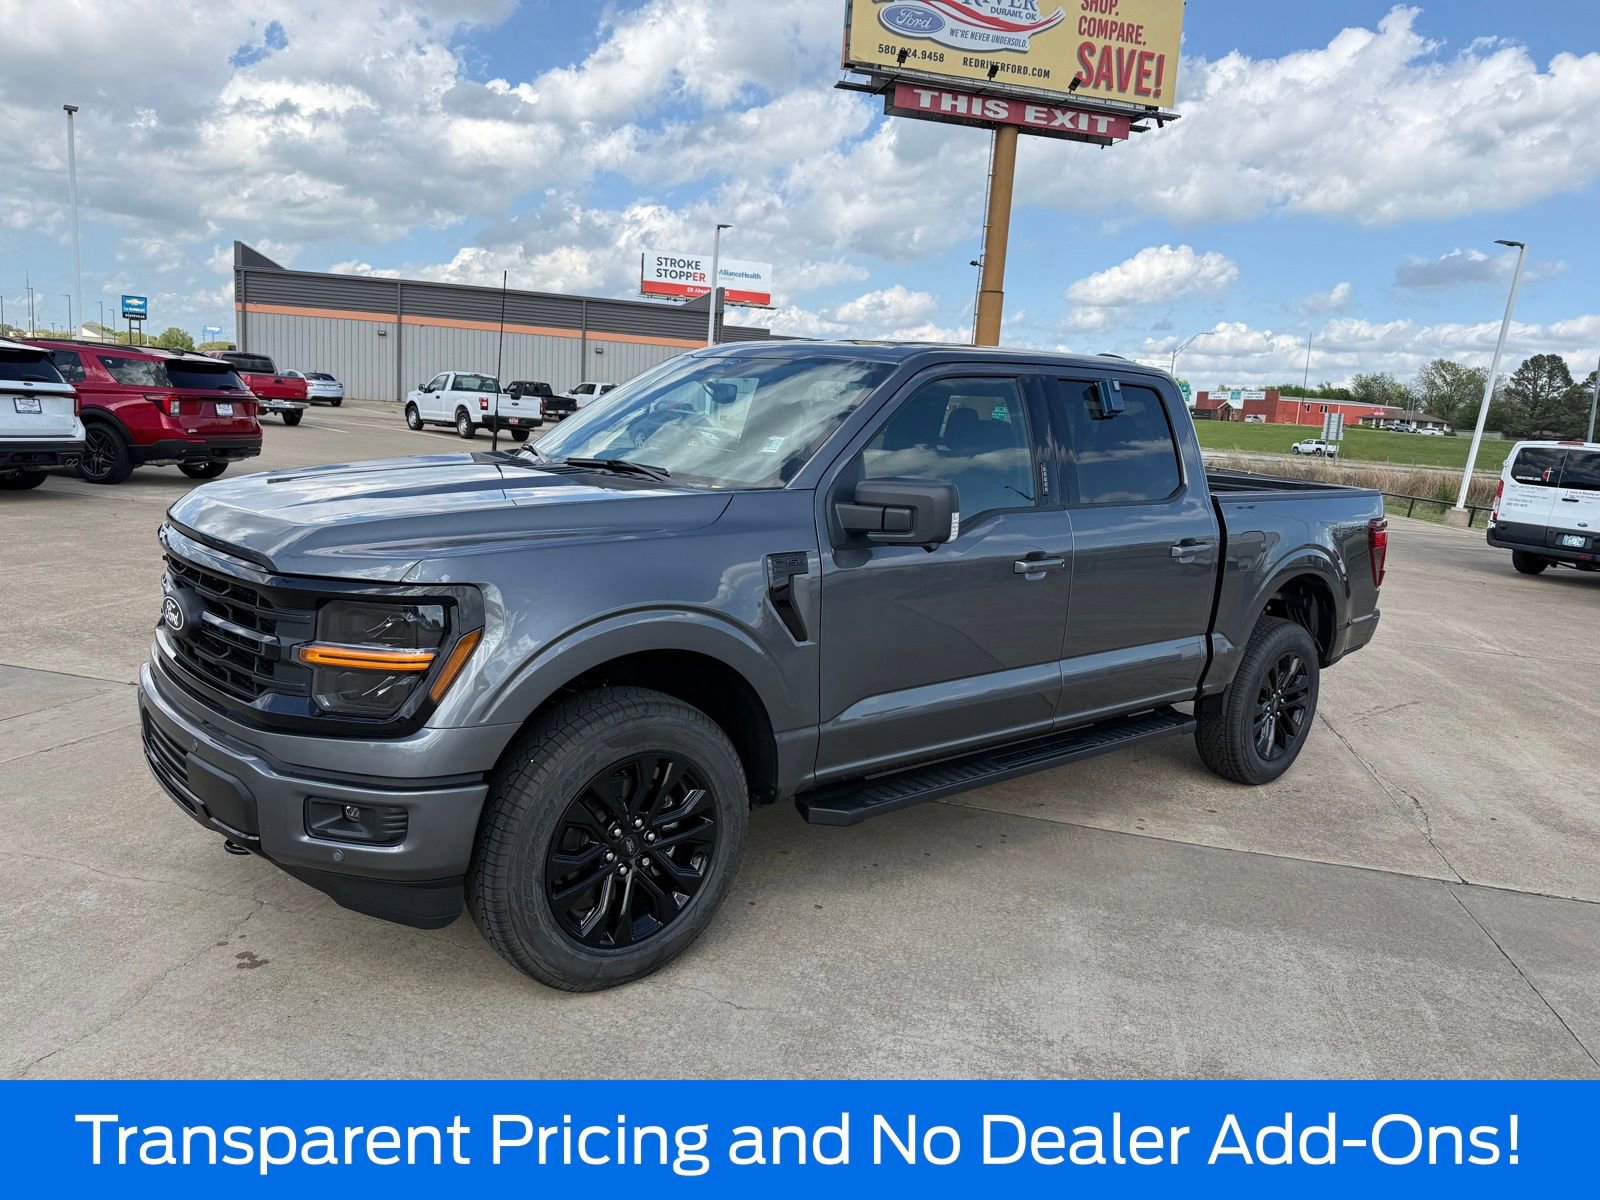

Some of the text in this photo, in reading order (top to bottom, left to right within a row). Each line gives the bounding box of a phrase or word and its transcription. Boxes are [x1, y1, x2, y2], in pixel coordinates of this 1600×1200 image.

[896, 8, 933, 29] Ford
[990, 6, 1037, 21] DURANT, OK
[1081, 0, 1119, 16] SHOP.
[949, 27, 1028, 48] WE'RE NEVER UNDERSOLD.
[1078, 15, 1147, 46] COMPARE.
[878, 43, 945, 63] 580.24.9458
[1077, 41, 1166, 98] SAVE!
[913, 88, 1115, 134] THIS EXIT
[656, 256, 701, 271] STROKE
[656, 268, 706, 283] STOPPER
[164, 599, 180, 627] Ford
